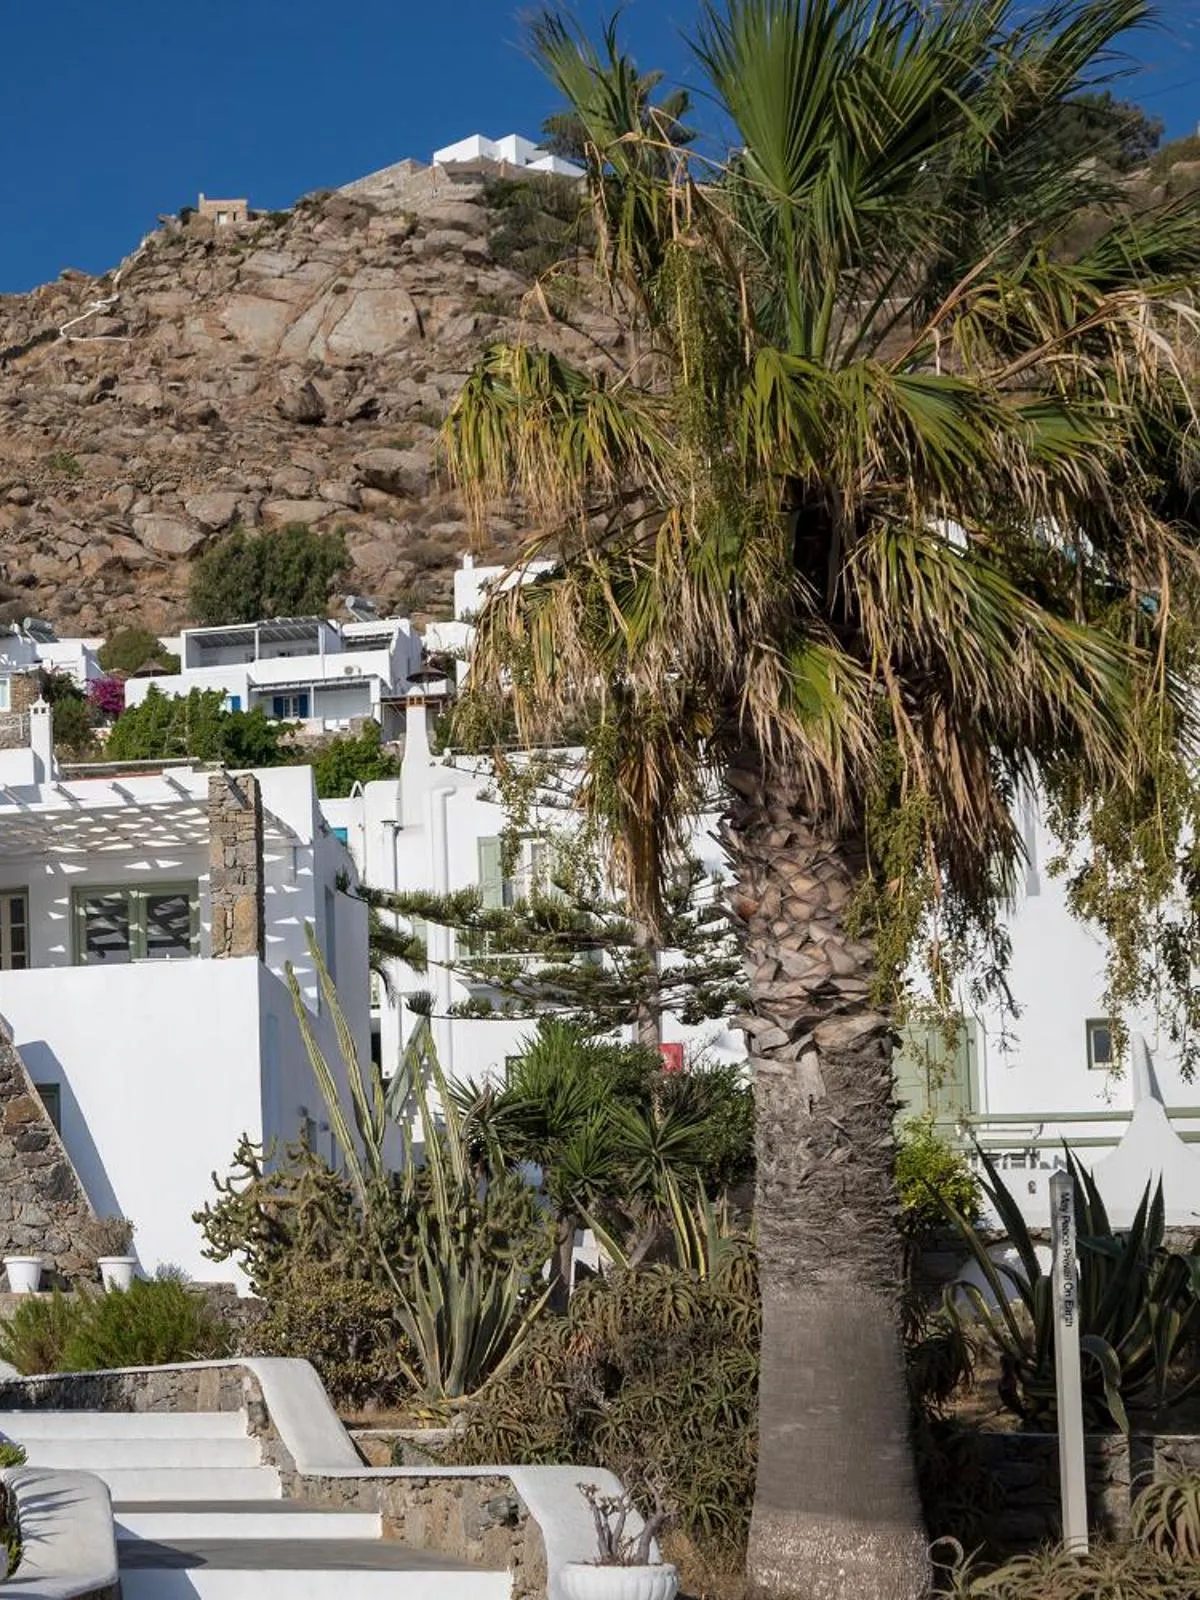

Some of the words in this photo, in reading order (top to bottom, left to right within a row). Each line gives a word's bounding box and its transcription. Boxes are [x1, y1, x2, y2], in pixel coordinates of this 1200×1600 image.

[1061, 1215, 1071, 1246] Peace
[1064, 1282, 1074, 1297] On
[1064, 1300, 1074, 1327] Earth
